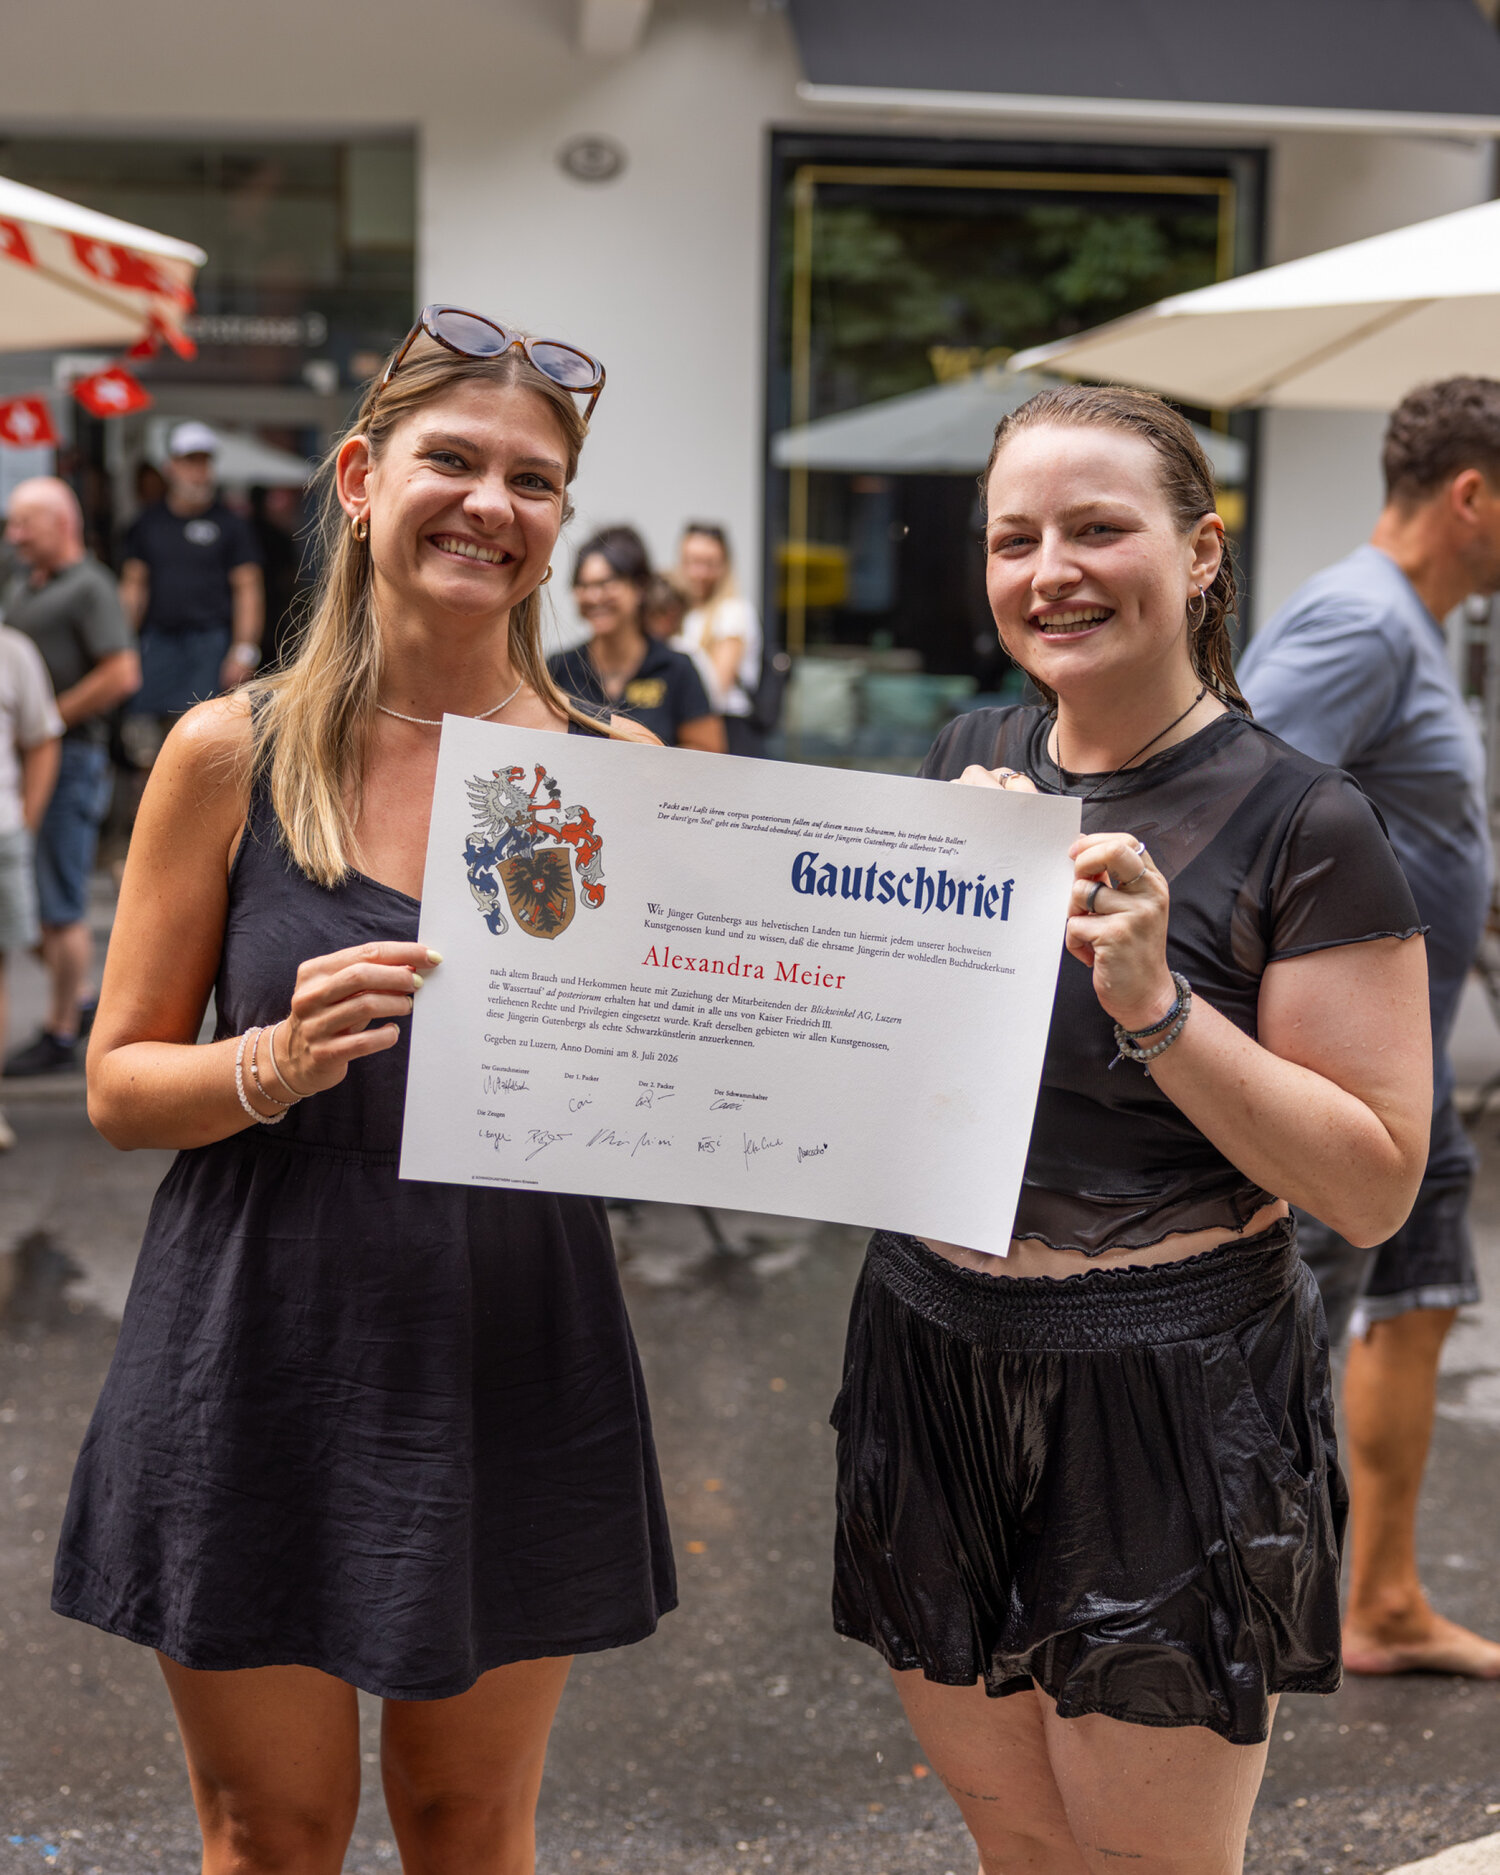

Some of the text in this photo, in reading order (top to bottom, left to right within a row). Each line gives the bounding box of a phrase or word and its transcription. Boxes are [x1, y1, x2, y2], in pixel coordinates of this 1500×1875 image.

[657, 812, 670, 820] Der
[740, 822, 770, 832] Sturzbad
[802, 829, 814, 838] das
[823, 832, 835, 840] der
[834, 833, 862, 844] Jüngerin
[863, 837, 898, 850] Gutenbergs
[898, 841, 909, 849] die
[909, 843, 937, 853] allerbeste
[709, 807, 725, 816] ihren
[727, 811, 749, 820] corpus
[751, 814, 791, 824] posteriorum
[791, 817, 810, 826] fallen
[811, 820, 823, 829] auf
[822, 821, 843, 830] diesen
[864, 826, 896, 838] Schwamm,
[897, 830, 907, 838] bis
[927, 834, 944, 843] beide
[944, 836, 967, 845] Ballen!
[791, 851, 1015, 922] Gautschbrief
[644, 919, 1016, 975] Kunstgenossen kund und zu wissen, daß die ehrsame Jüngerin der wohledlen Buchdruckerkunst
[647, 902, 992, 957] Wir Jünger Gutenbergs aus helvetischen Landen tun hiermit jedem unserer hochweisen
[641, 945, 846, 989] Alexandra Meier
[488, 980, 500, 990] die
[545, 988, 557, 997] ad
[556, 991, 602, 1002] posteriorum
[604, 994, 636, 1006] erhalten
[638, 997, 651, 1008] hat
[653, 1001, 670, 1010] und
[671, 1001, 695, 1013] damit
[708, 1006, 722, 1016] alle
[724, 1010, 738, 1018] uns
[740, 1012, 756, 1020] von
[758, 1012, 784, 1023] Kaiser
[785, 1015, 821, 1028] Friedrich
[821, 1020, 833, 1029] III.
[490, 968, 902, 1025] nach altem Brauch und Herkommen heute mit Zuziehung der Mitarbeitenden der Blickwinkel AG, Luzern
[486, 1008, 755, 1048] diese Jüngerin Gutenbergs als echte Schwarzkünstlerin anzuerkennen.
[487, 995, 890, 1051] verliehenen Rechte und Privilegien eingesetzt wurde. Kraft derselben gebieten wir allen Kunstgenossen,
[483, 1033, 517, 1046] Gegeben
[529, 1039, 558, 1051] Luzern,
[560, 1042, 582, 1053] Anno
[584, 1044, 614, 1056] Domini
[616, 1050, 629, 1058] am
[631, 1050, 639, 1059] 8.
[640, 1051, 655, 1062] Juli
[657, 1052, 678, 1063] 2026
[581, 1074, 599, 1082] Packer
[656, 1082, 674, 1090] Packer
[725, 1090, 769, 1101] Schwammhalter
[487, 1110, 506, 1118] Zeugen
